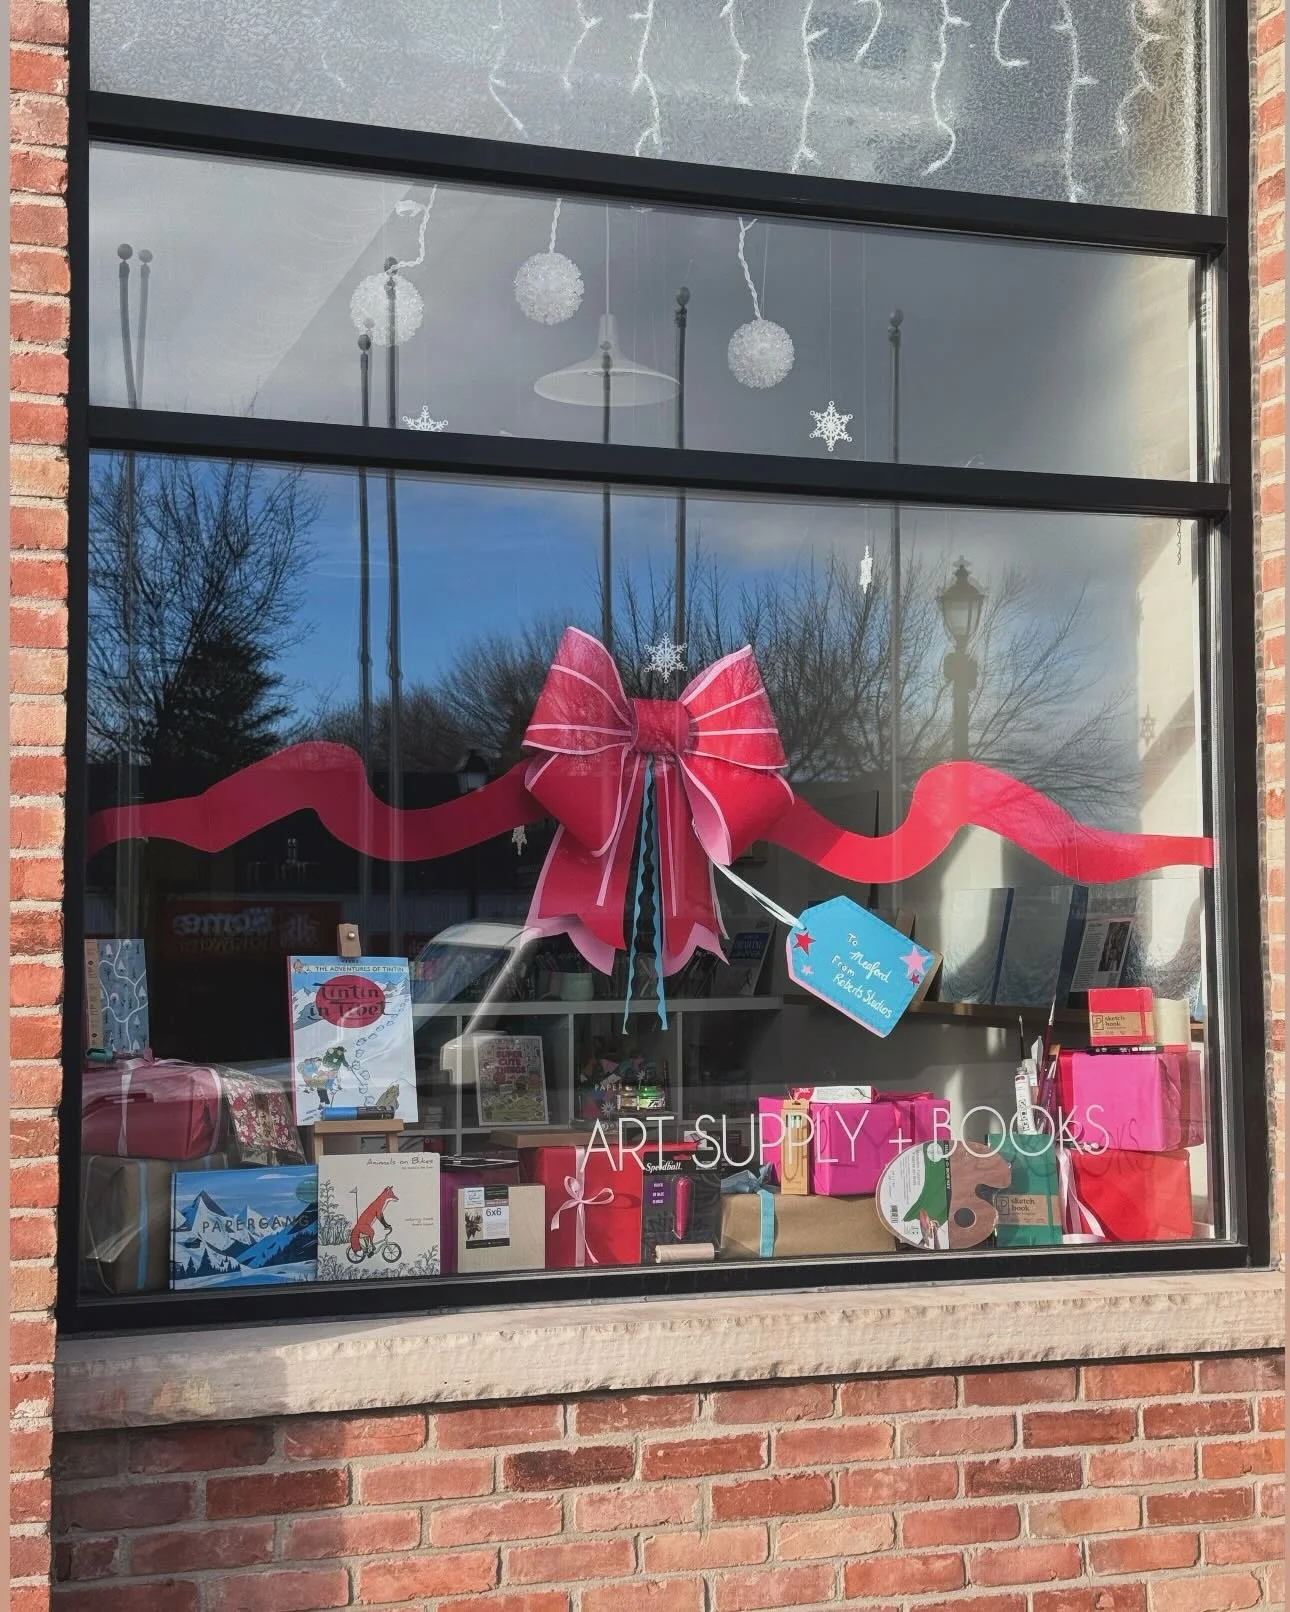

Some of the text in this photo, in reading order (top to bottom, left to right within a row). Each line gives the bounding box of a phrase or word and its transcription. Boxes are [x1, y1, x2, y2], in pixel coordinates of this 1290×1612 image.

[847, 932, 858, 946] To
[831, 955, 855, 977] From
[833, 973, 893, 1019] Roberts Studios
[580, 1116, 675, 1172] ART
[692, 1110, 870, 1166] SUPPLY
[934, 1105, 1109, 1158] BOOKS
[366, 1158, 396, 1166] Animals
[412, 1156, 434, 1165] Bikes
[645, 1160, 681, 1174] Spedball
[485, 1207, 502, 1217] 6x6
[202, 1215, 310, 1234] PAPERGANG
